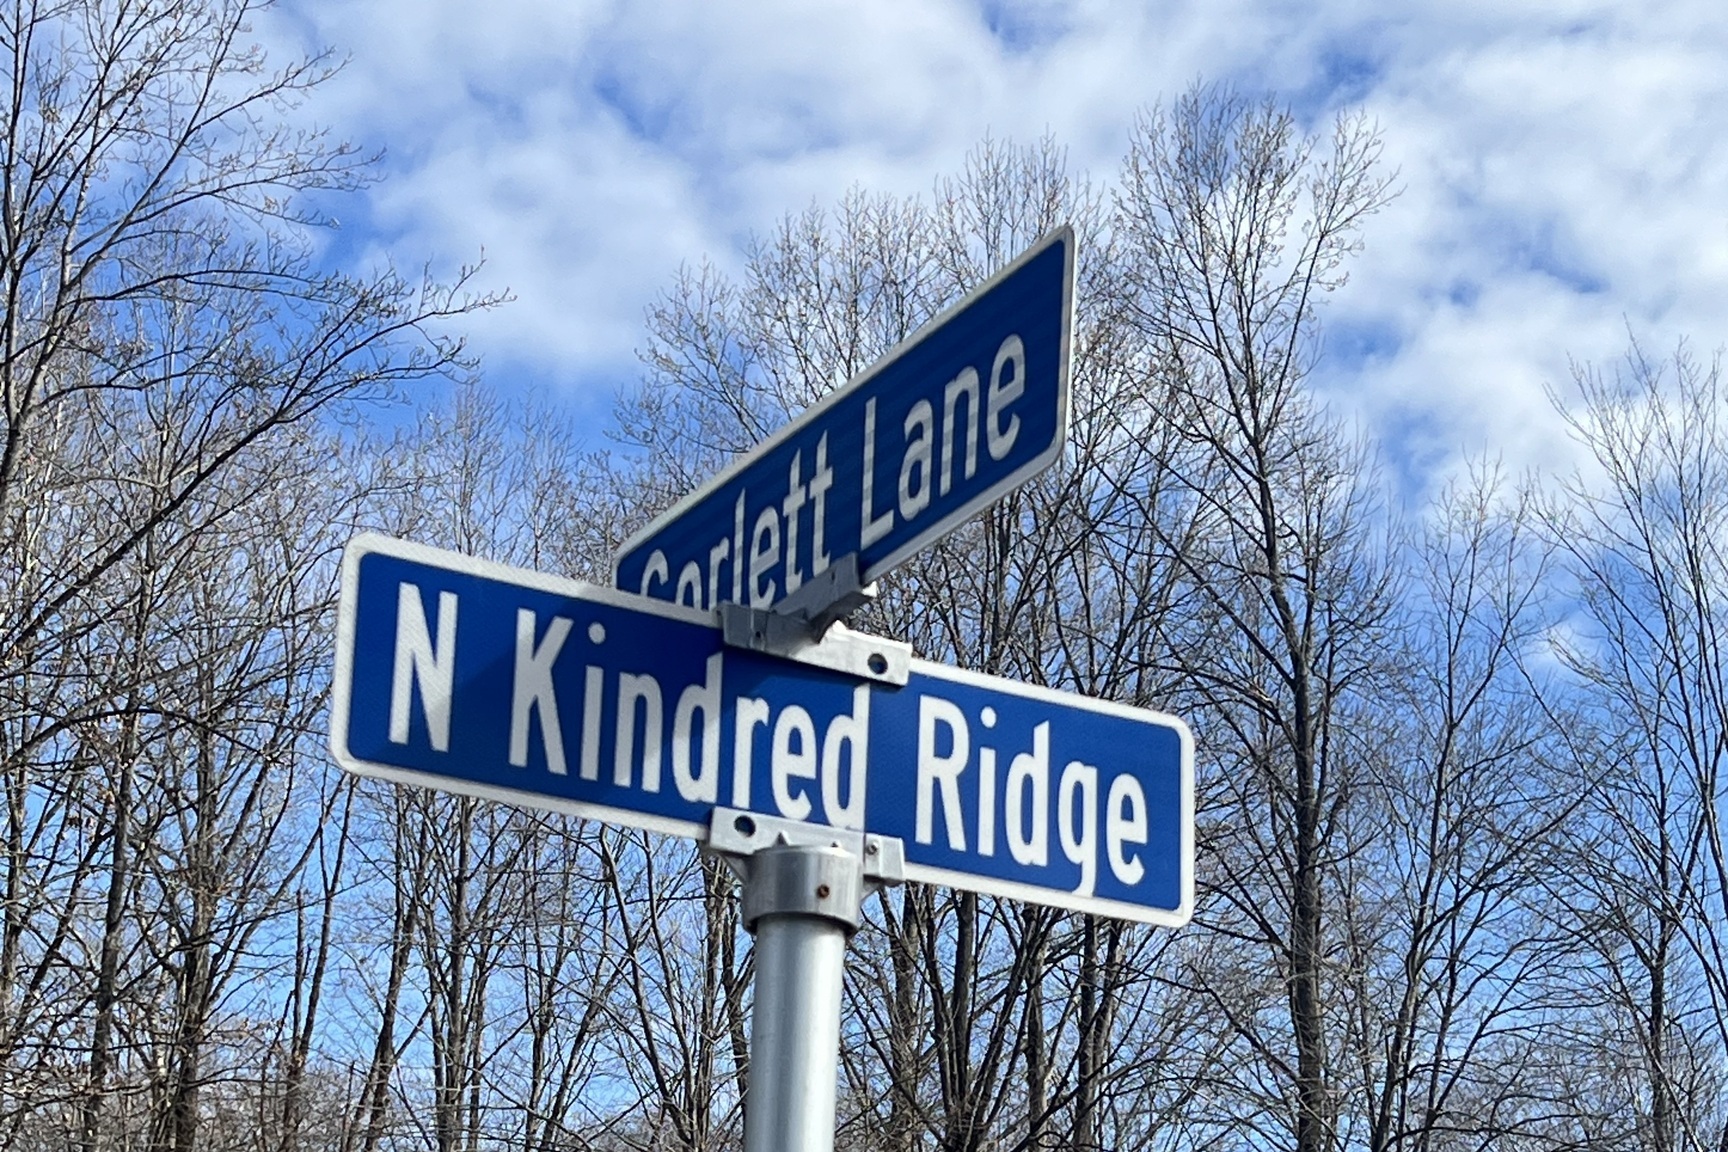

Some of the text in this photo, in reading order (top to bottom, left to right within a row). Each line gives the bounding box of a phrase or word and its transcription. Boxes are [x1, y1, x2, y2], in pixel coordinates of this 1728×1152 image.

[860, 333, 1026, 551] Lane
[389, 582, 1149, 898] N Kindred Ridge
